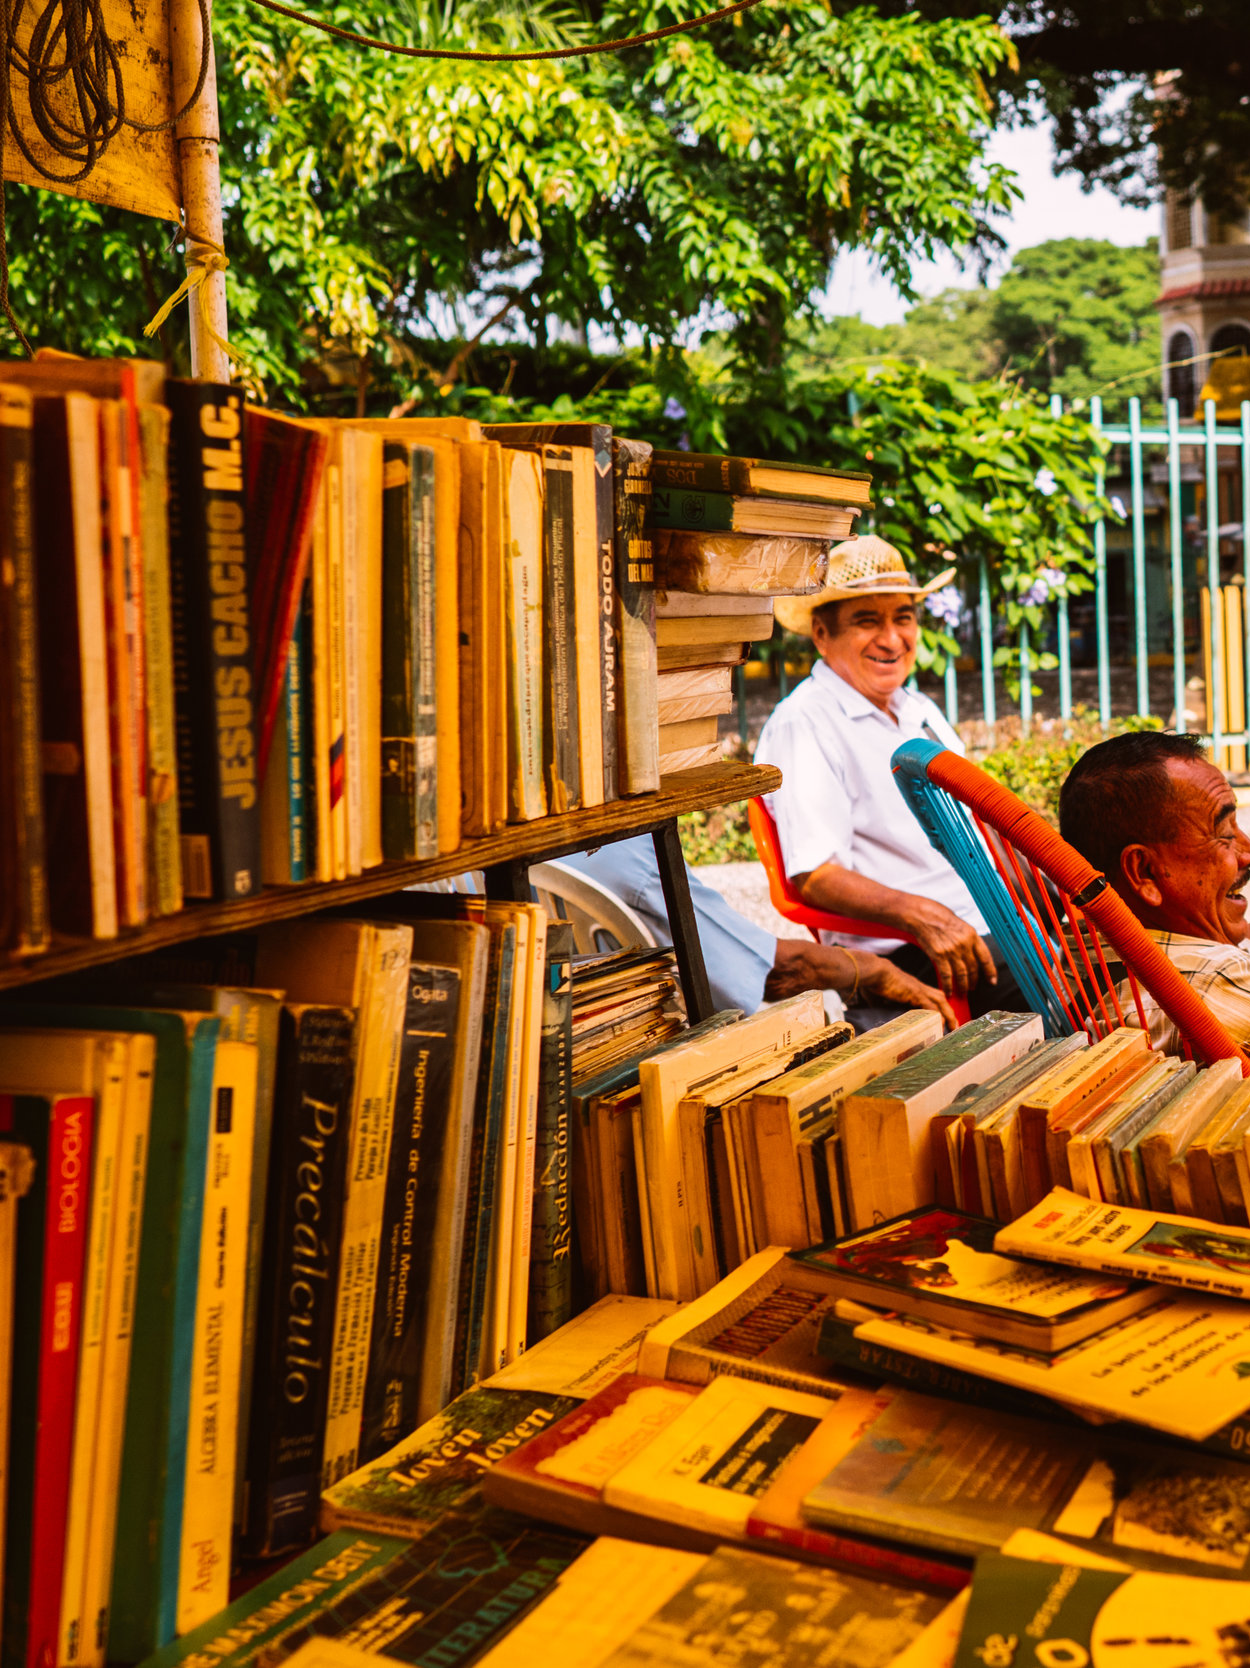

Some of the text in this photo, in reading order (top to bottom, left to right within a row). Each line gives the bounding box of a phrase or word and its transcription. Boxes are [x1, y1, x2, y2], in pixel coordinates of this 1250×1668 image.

[202, 395, 256, 810] JESUS CACHO M.C.
[599, 538, 616, 711] TODO AJRAM
[284, 1091, 338, 1405] Precálculo
[394, 1050, 430, 1337] Ingeniería de Control Moderna
[553, 1032, 570, 1261] Redacción AVANZADA
[203, 1304, 224, 1395] ELEMENTAL
